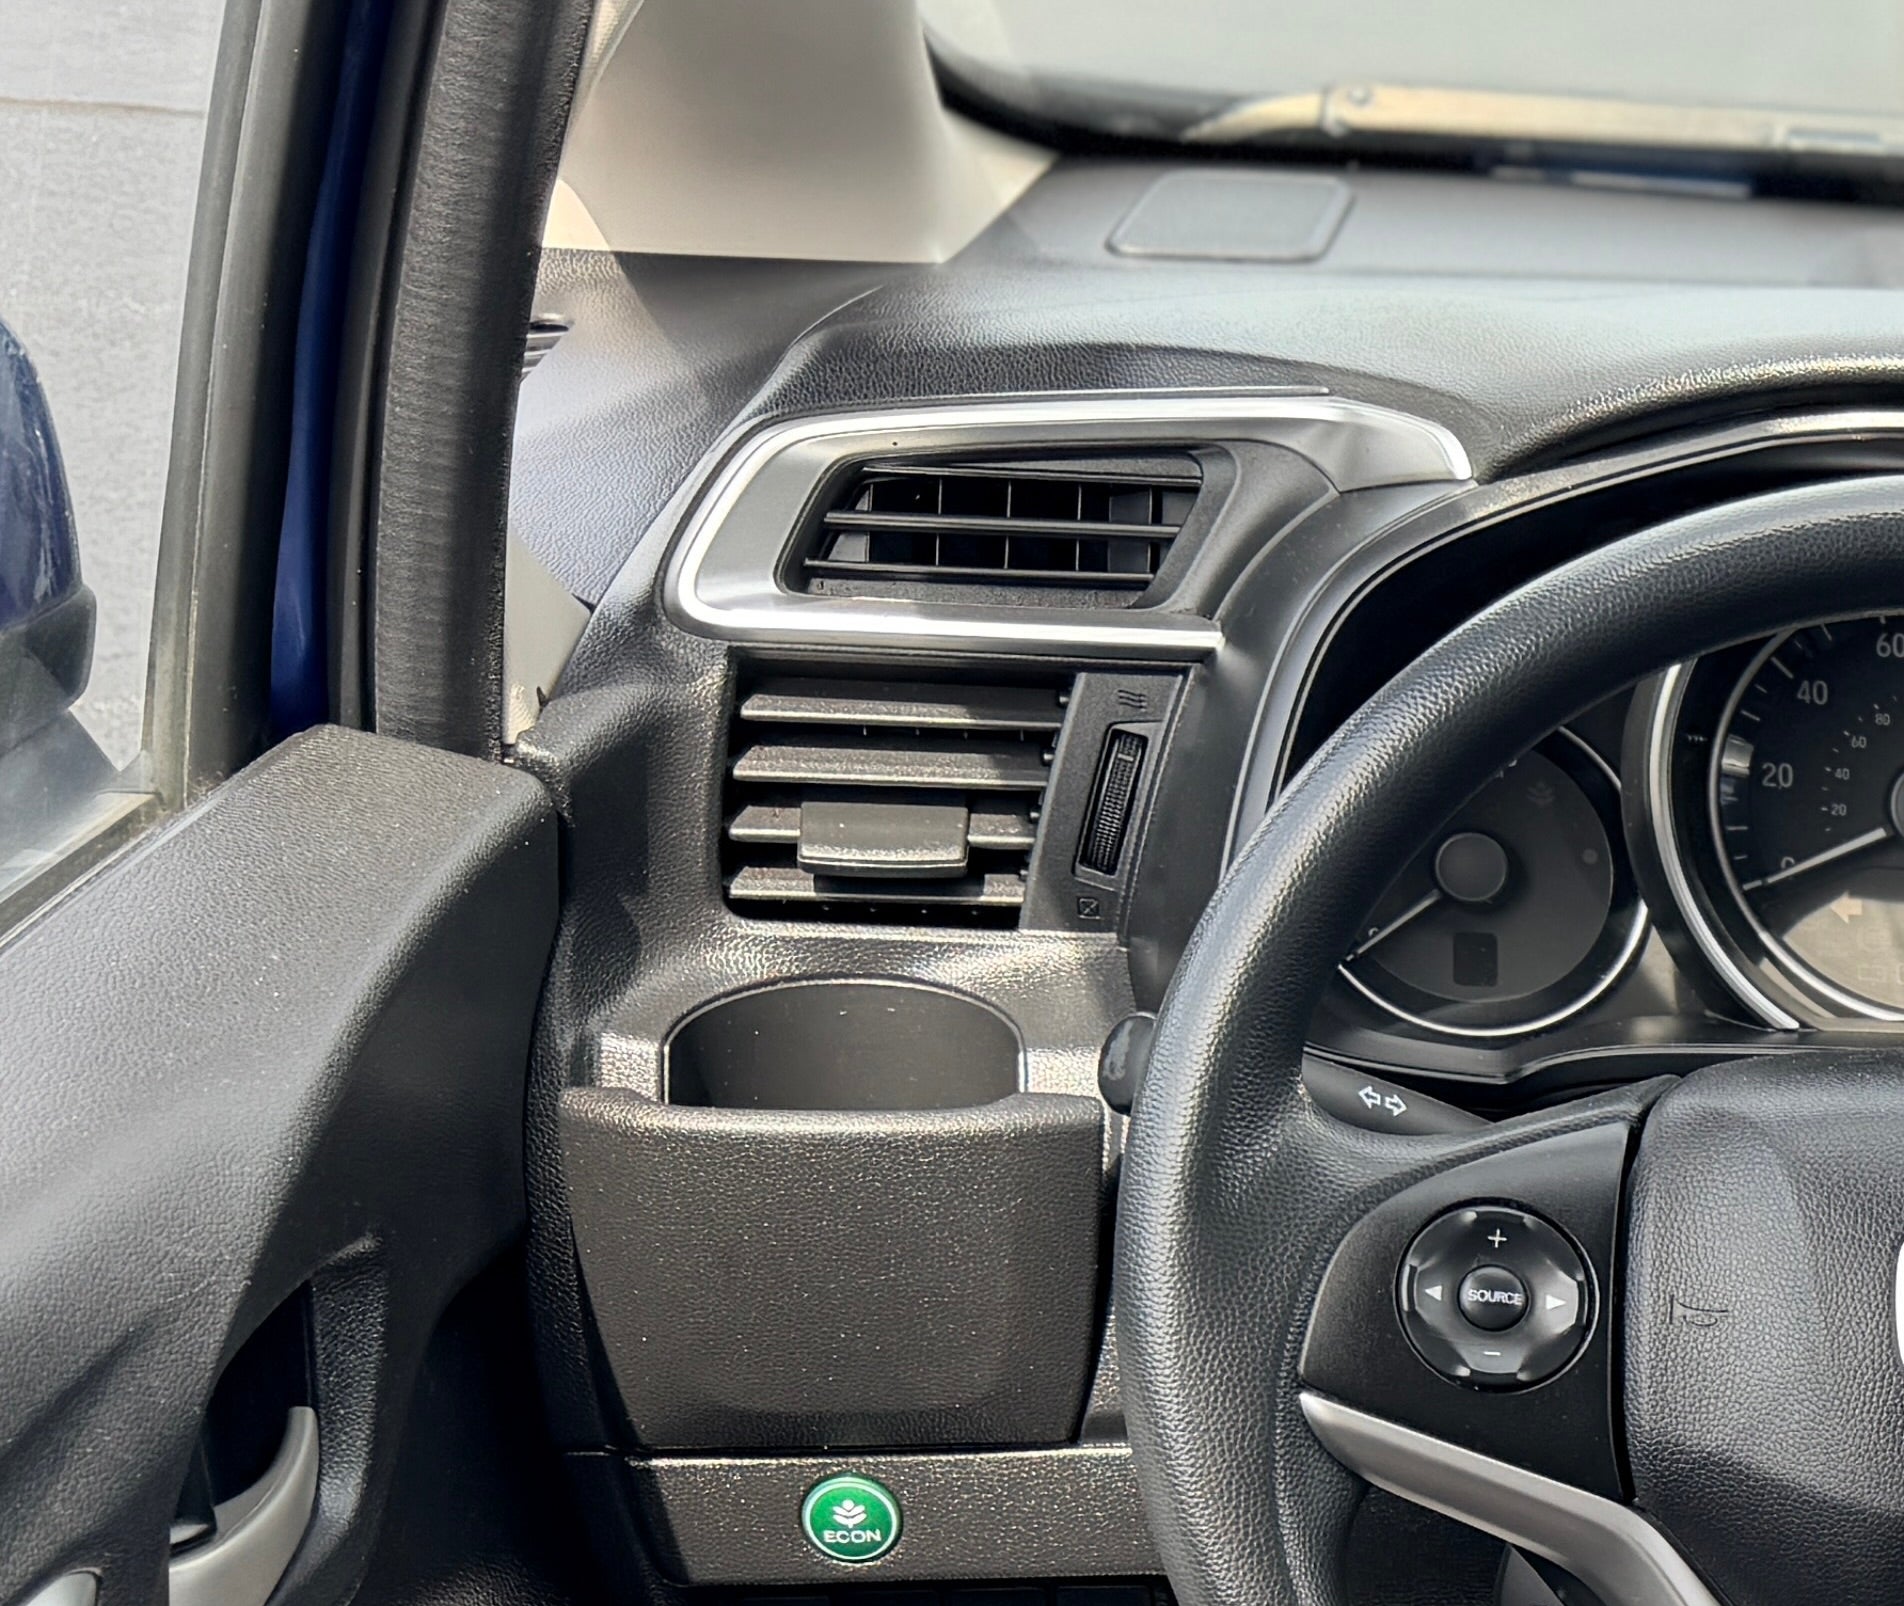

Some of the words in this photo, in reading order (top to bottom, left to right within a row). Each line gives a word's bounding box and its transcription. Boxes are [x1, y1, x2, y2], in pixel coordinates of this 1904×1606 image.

[1797, 680, 1828, 705] 40
[1875, 713, 1890, 726] 80
[1851, 735, 1867, 749] 60
[1762, 762, 1794, 788] 20
[1834, 767, 1850, 781] 40
[1831, 803, 1847, 816] 20
[1467, 1288, 1523, 1307] SOURCE
[823, 1529, 882, 1545] ECON
